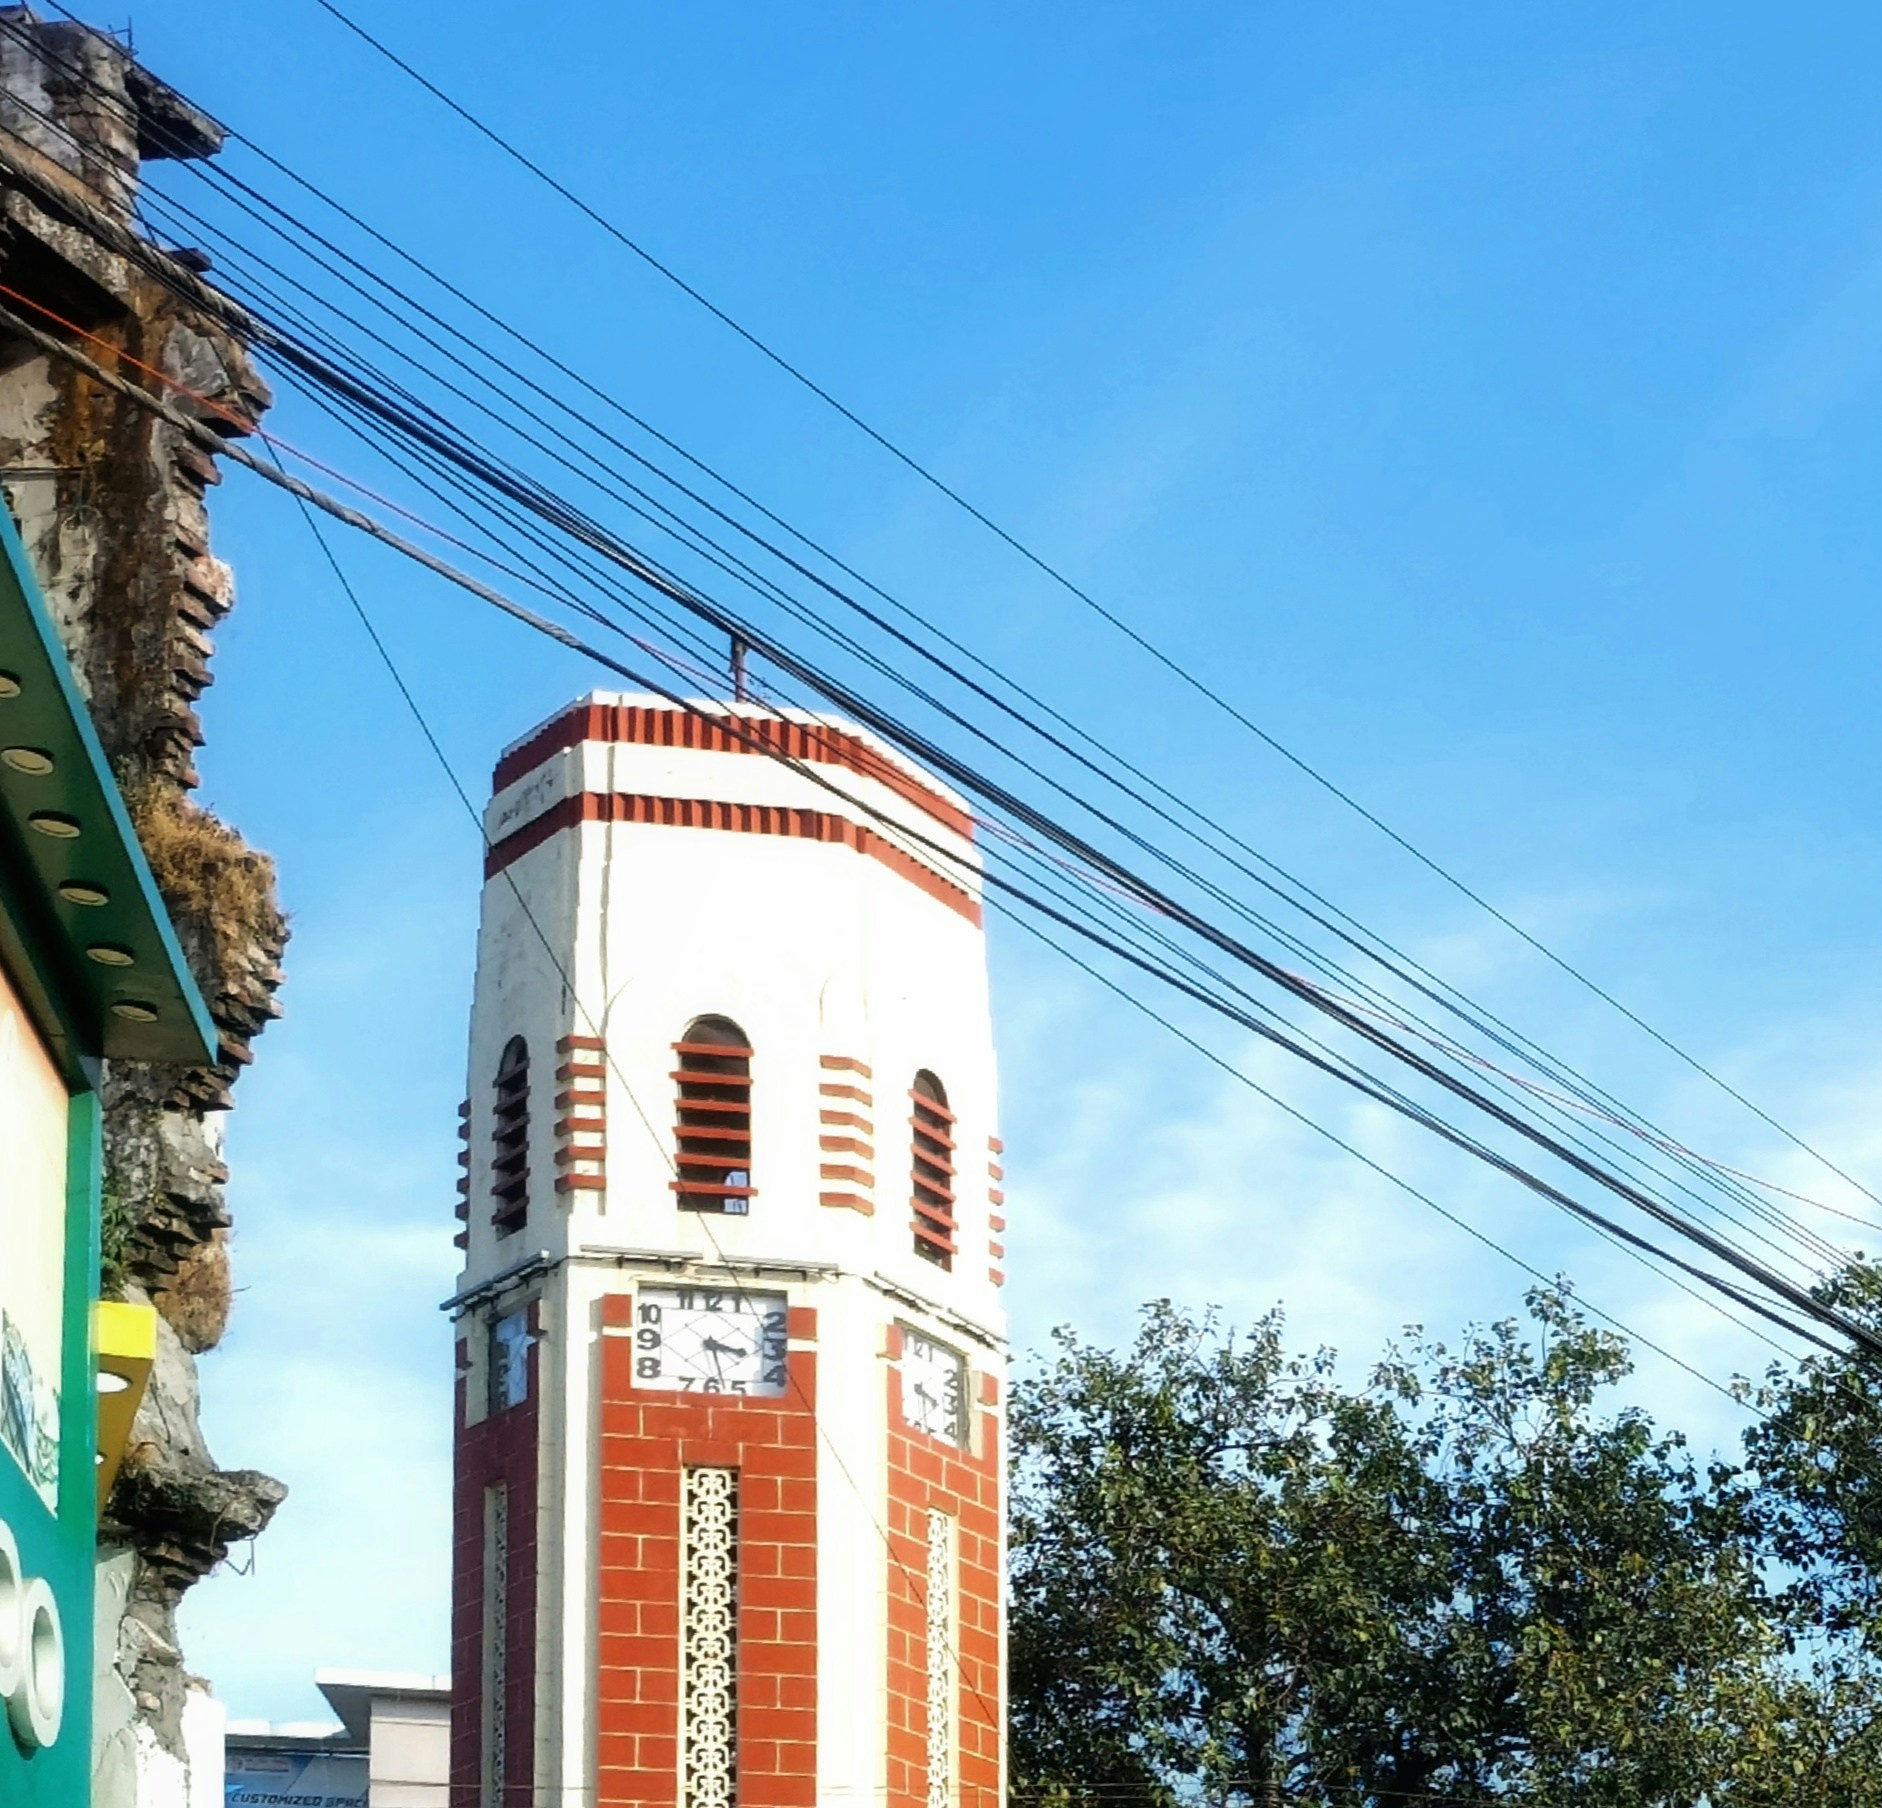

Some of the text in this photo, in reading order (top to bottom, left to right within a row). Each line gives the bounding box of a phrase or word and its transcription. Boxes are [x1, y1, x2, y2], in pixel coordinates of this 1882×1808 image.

[702, 1290, 722, 1312] 12
[638, 1303, 661, 1325] 10
[764, 1312, 788, 1333] 2
[637, 1329, 661, 1350] 9
[763, 1338, 788, 1361] 3
[637, 1357, 661, 1379] 8
[764, 1365, 788, 1388] 4
[679, 1377, 696, 1391] 7
[704, 1377, 721, 1393] 6
[731, 1380, 746, 1395] 5
[231, 1792, 322, 1807] CUSTOMIZED
